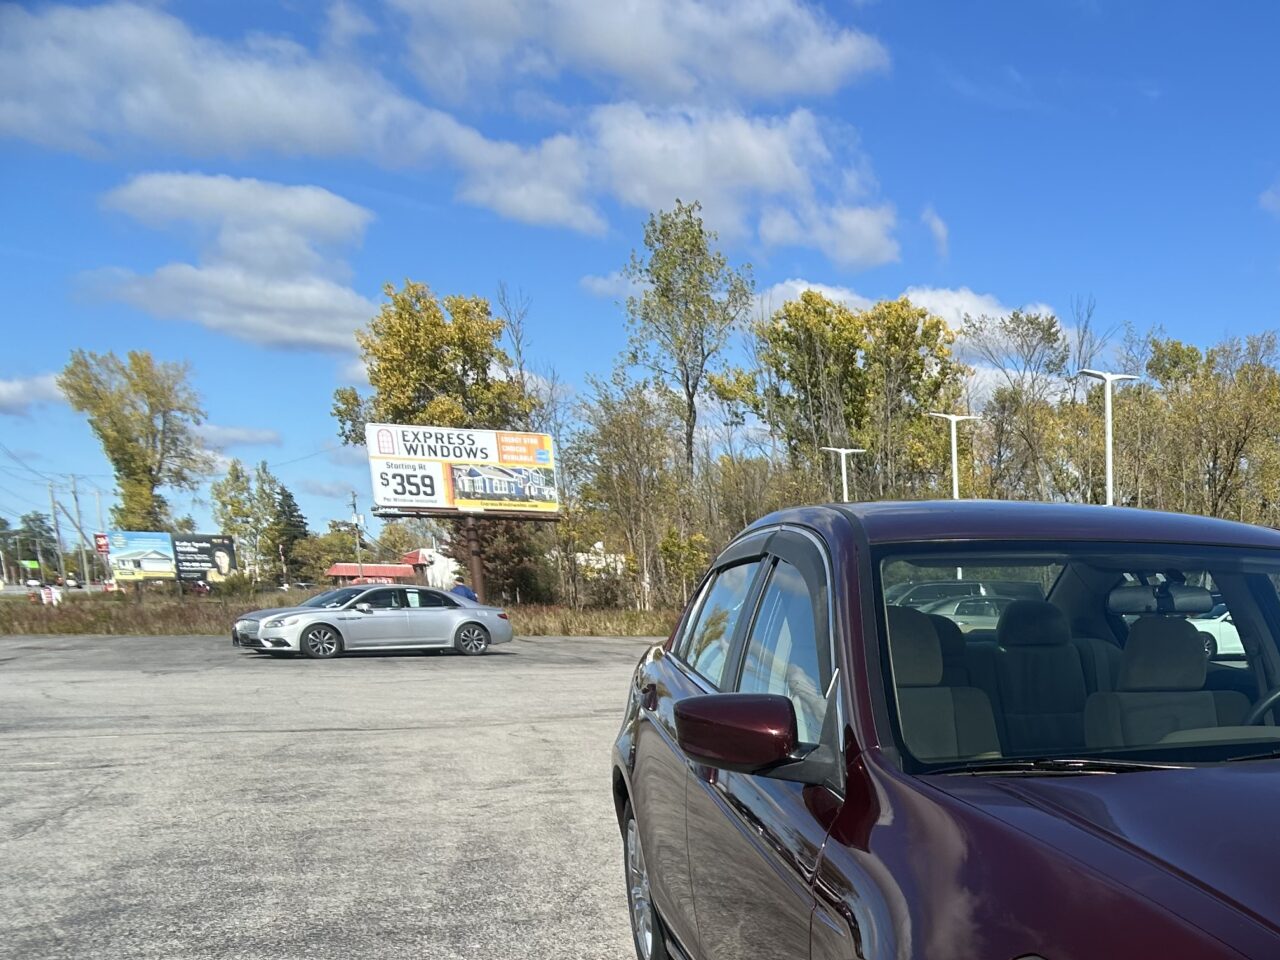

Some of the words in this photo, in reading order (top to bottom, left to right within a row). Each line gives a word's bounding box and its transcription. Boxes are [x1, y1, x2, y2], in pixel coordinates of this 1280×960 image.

[402, 430, 476, 446] EXPRESS
[403, 443, 489, 460] WINDOWS
[386, 462, 417, 471] Starting
